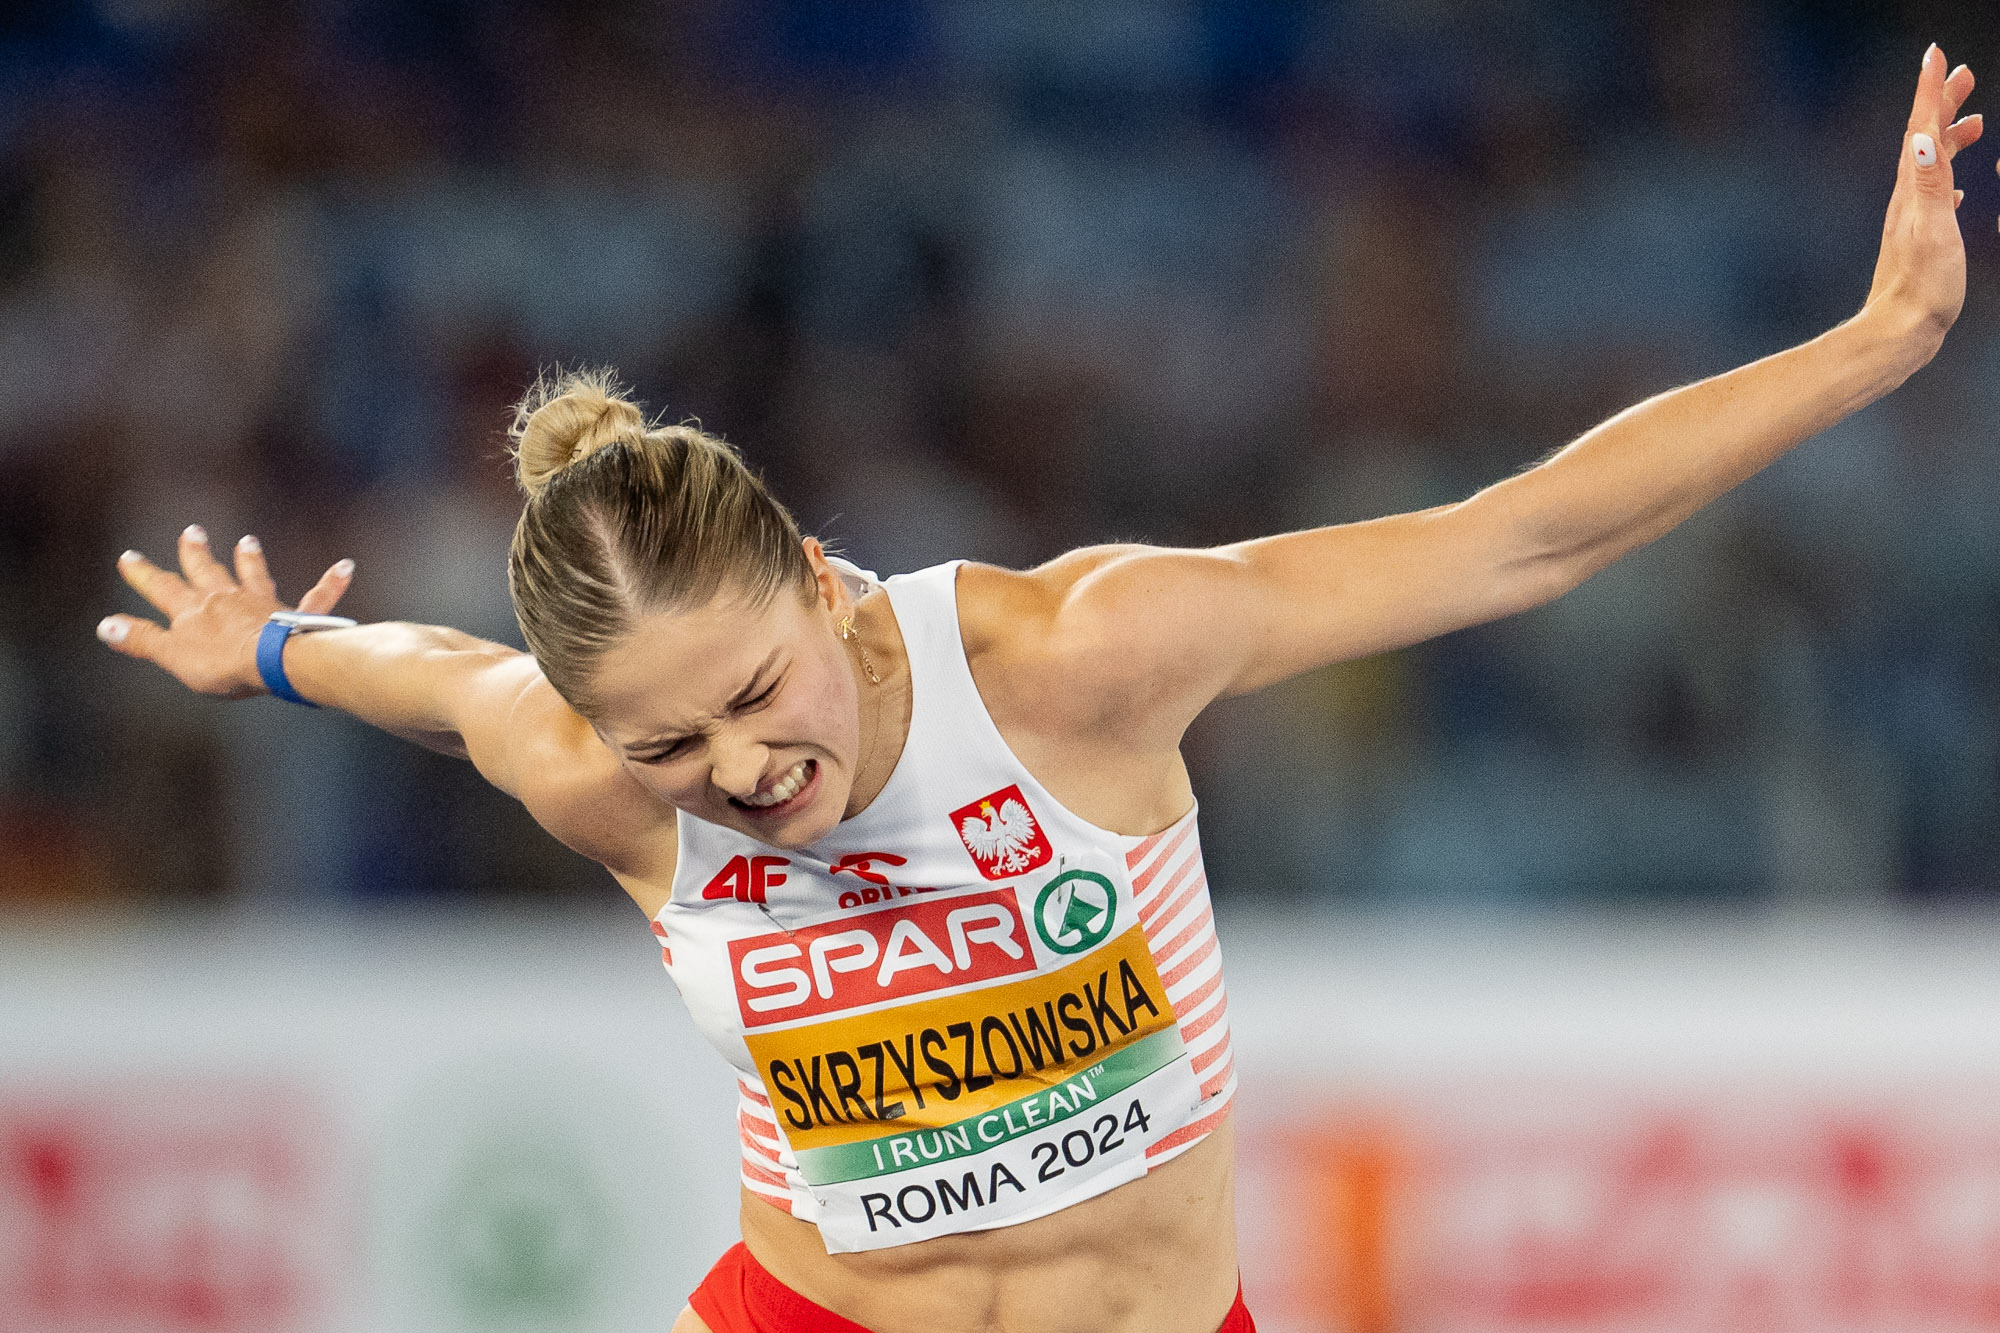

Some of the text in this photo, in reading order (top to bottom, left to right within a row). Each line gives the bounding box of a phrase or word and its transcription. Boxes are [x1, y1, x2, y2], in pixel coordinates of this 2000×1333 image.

[740, 904, 1025, 1013] SPAR
[769, 958, 1160, 1131] SKRZYSZOWSKA
[860, 1098, 1151, 1233] ROMA 2024
[872, 1143, 885, 1171] I
[889, 1126, 971, 1167] RUN
